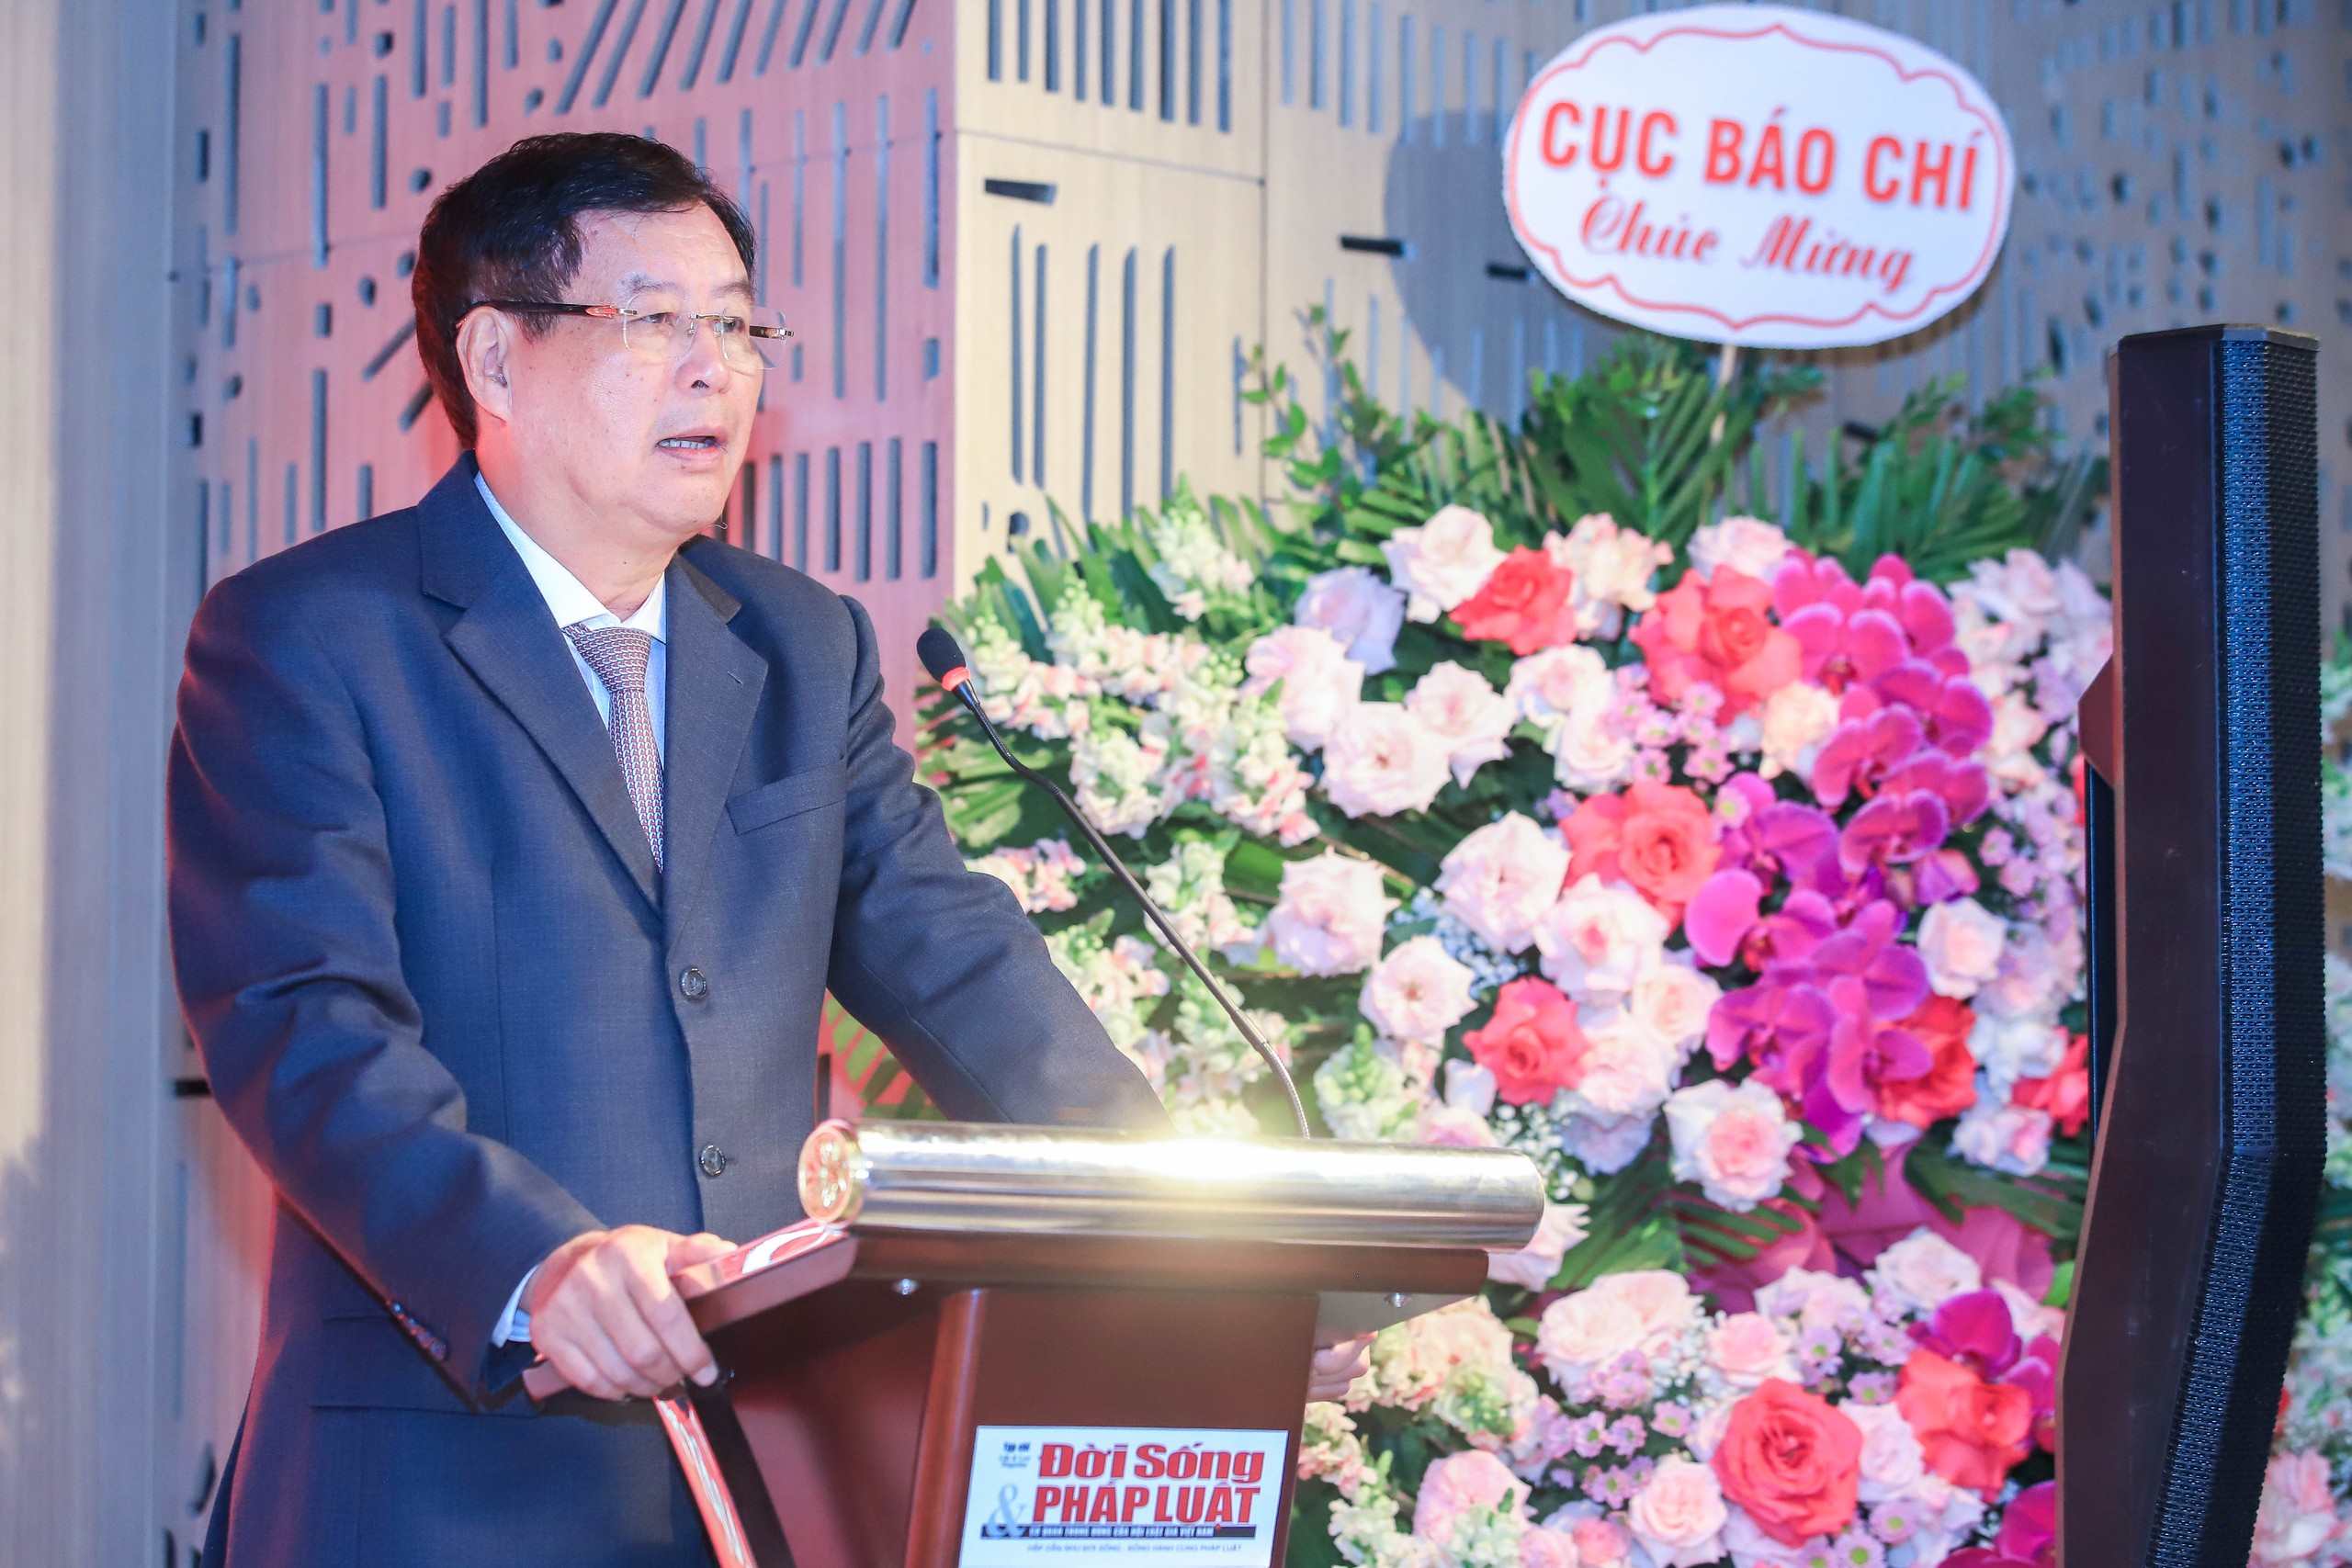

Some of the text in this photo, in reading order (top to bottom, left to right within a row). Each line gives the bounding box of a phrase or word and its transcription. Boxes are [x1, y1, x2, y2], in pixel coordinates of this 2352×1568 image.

[1541, 100, 1986, 210] CỤC BÁO CHÍ
[1579, 194, 1915, 293] Chúc Mừng
[1038, 1441, 1265, 1484] Đời Sống
[1032, 1480, 1150, 1524] PHÁP
[1153, 1481, 1261, 1530] LUẬT
